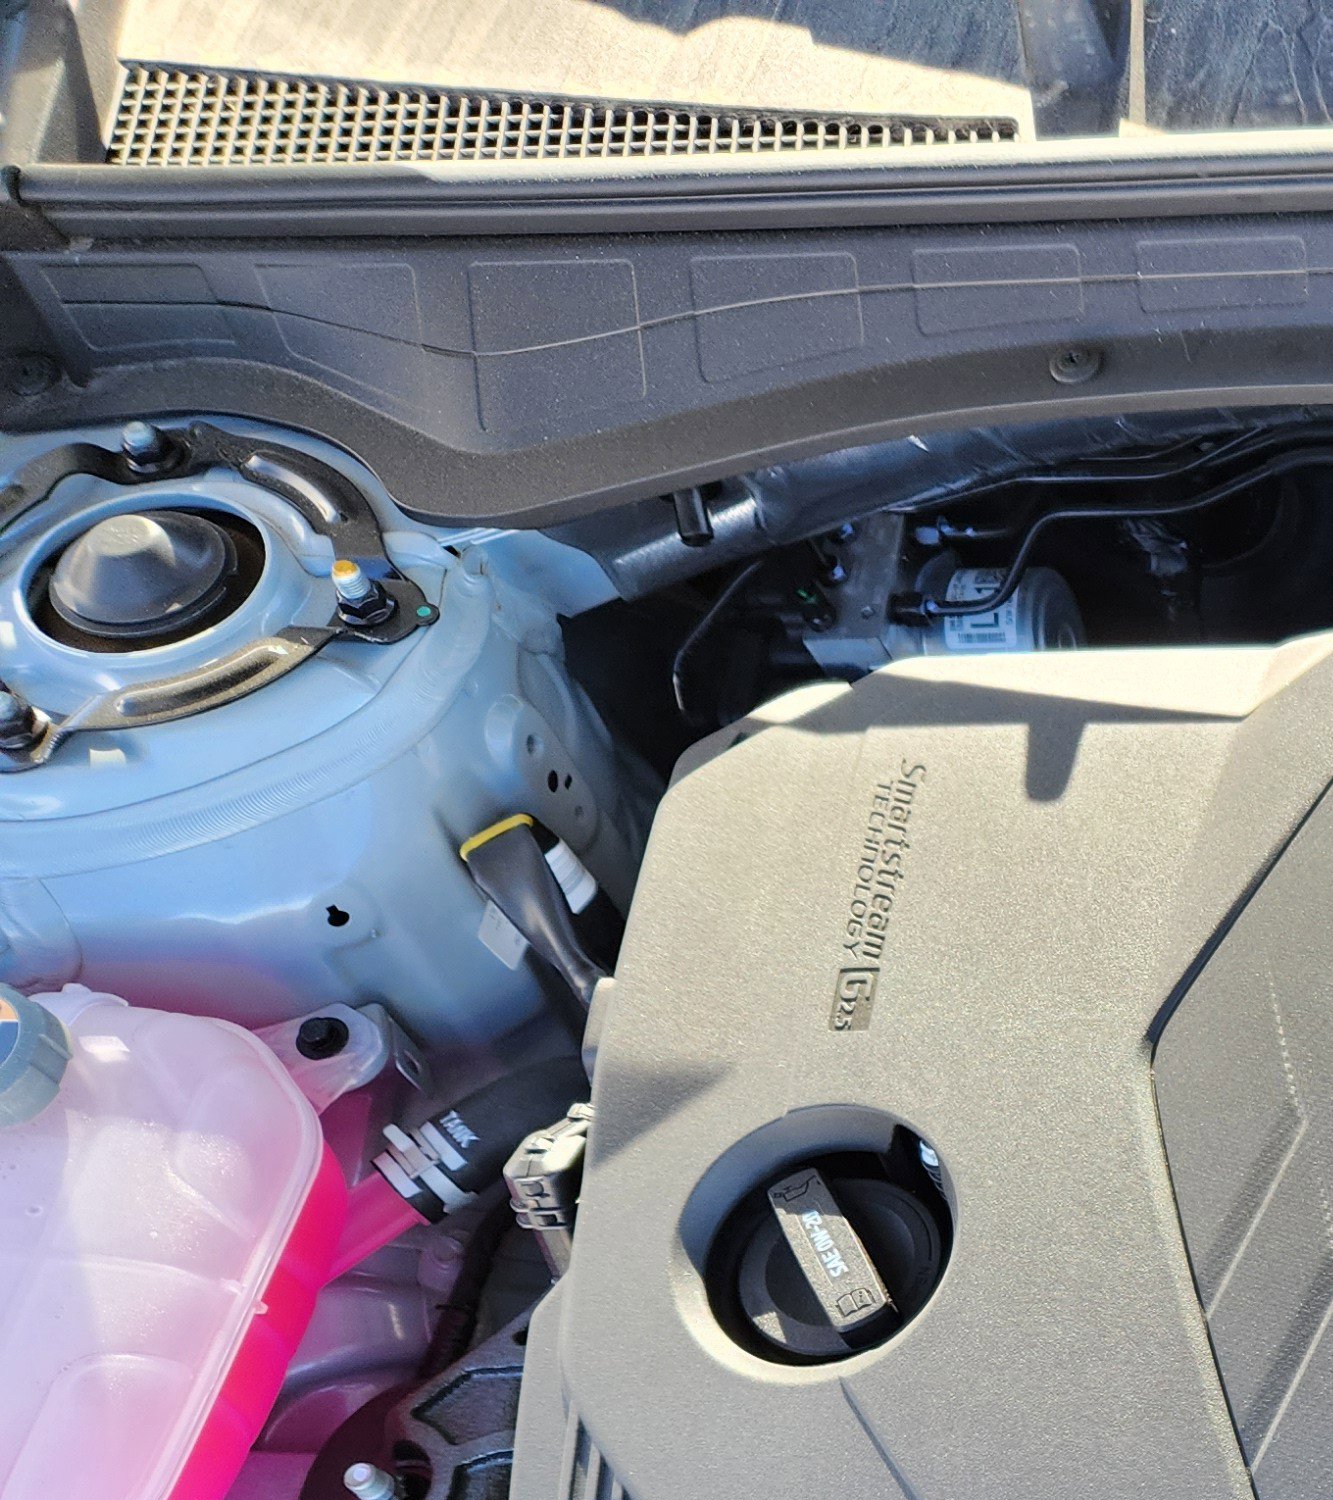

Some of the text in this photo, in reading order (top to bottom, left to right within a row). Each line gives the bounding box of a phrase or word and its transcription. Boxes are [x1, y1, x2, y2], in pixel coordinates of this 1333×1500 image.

[842, 780, 892, 960] TECHNOLOGY
[862, 758, 928, 960] Smartstream
[439, 1109, 481, 1149] TANK
[801, 1210, 850, 1278] SAE 0W-20
